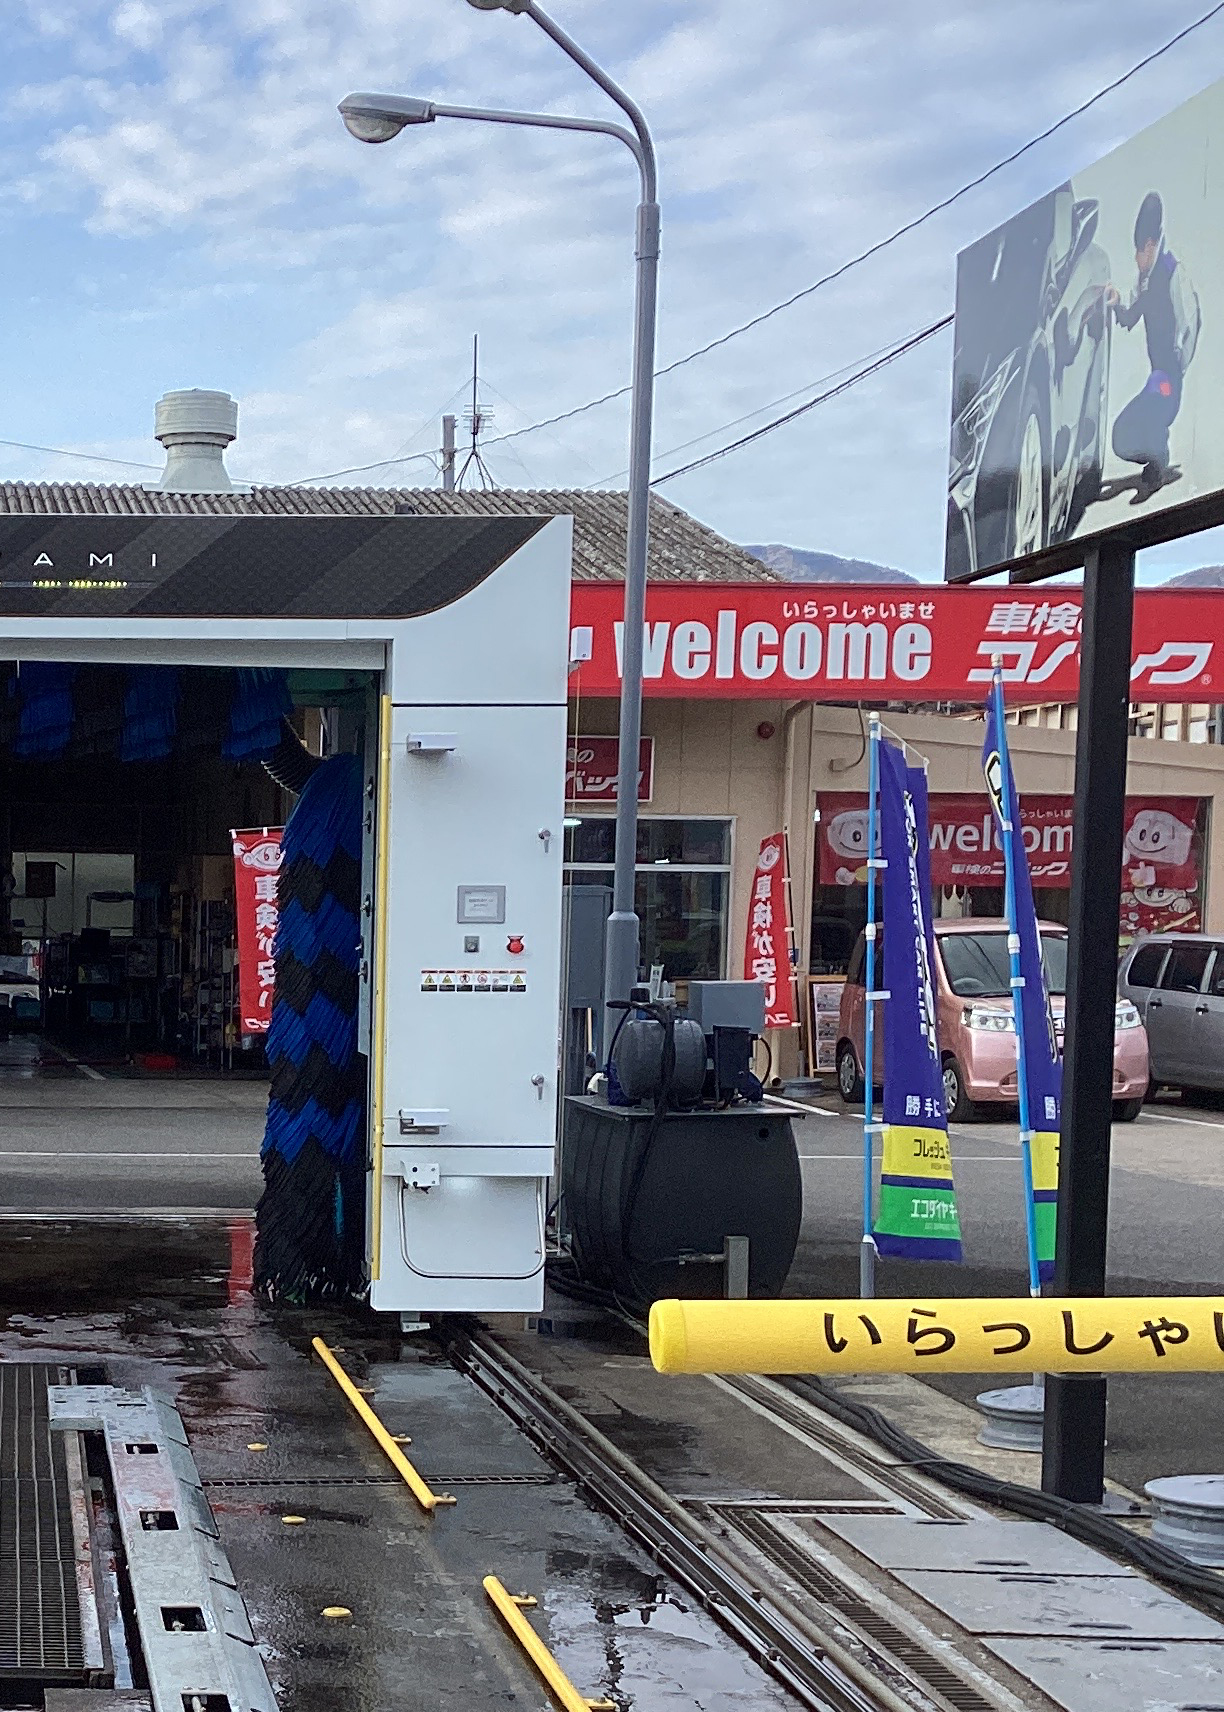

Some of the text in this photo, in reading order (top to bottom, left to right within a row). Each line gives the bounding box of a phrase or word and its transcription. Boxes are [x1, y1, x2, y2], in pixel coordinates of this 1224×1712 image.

[782, 600, 936, 620] いらっしゃいませ
[984, 601, 1084, 635] 車検
[613, 609, 933, 681] welcome
[1019, 808, 1074, 819] らっしゃいま
